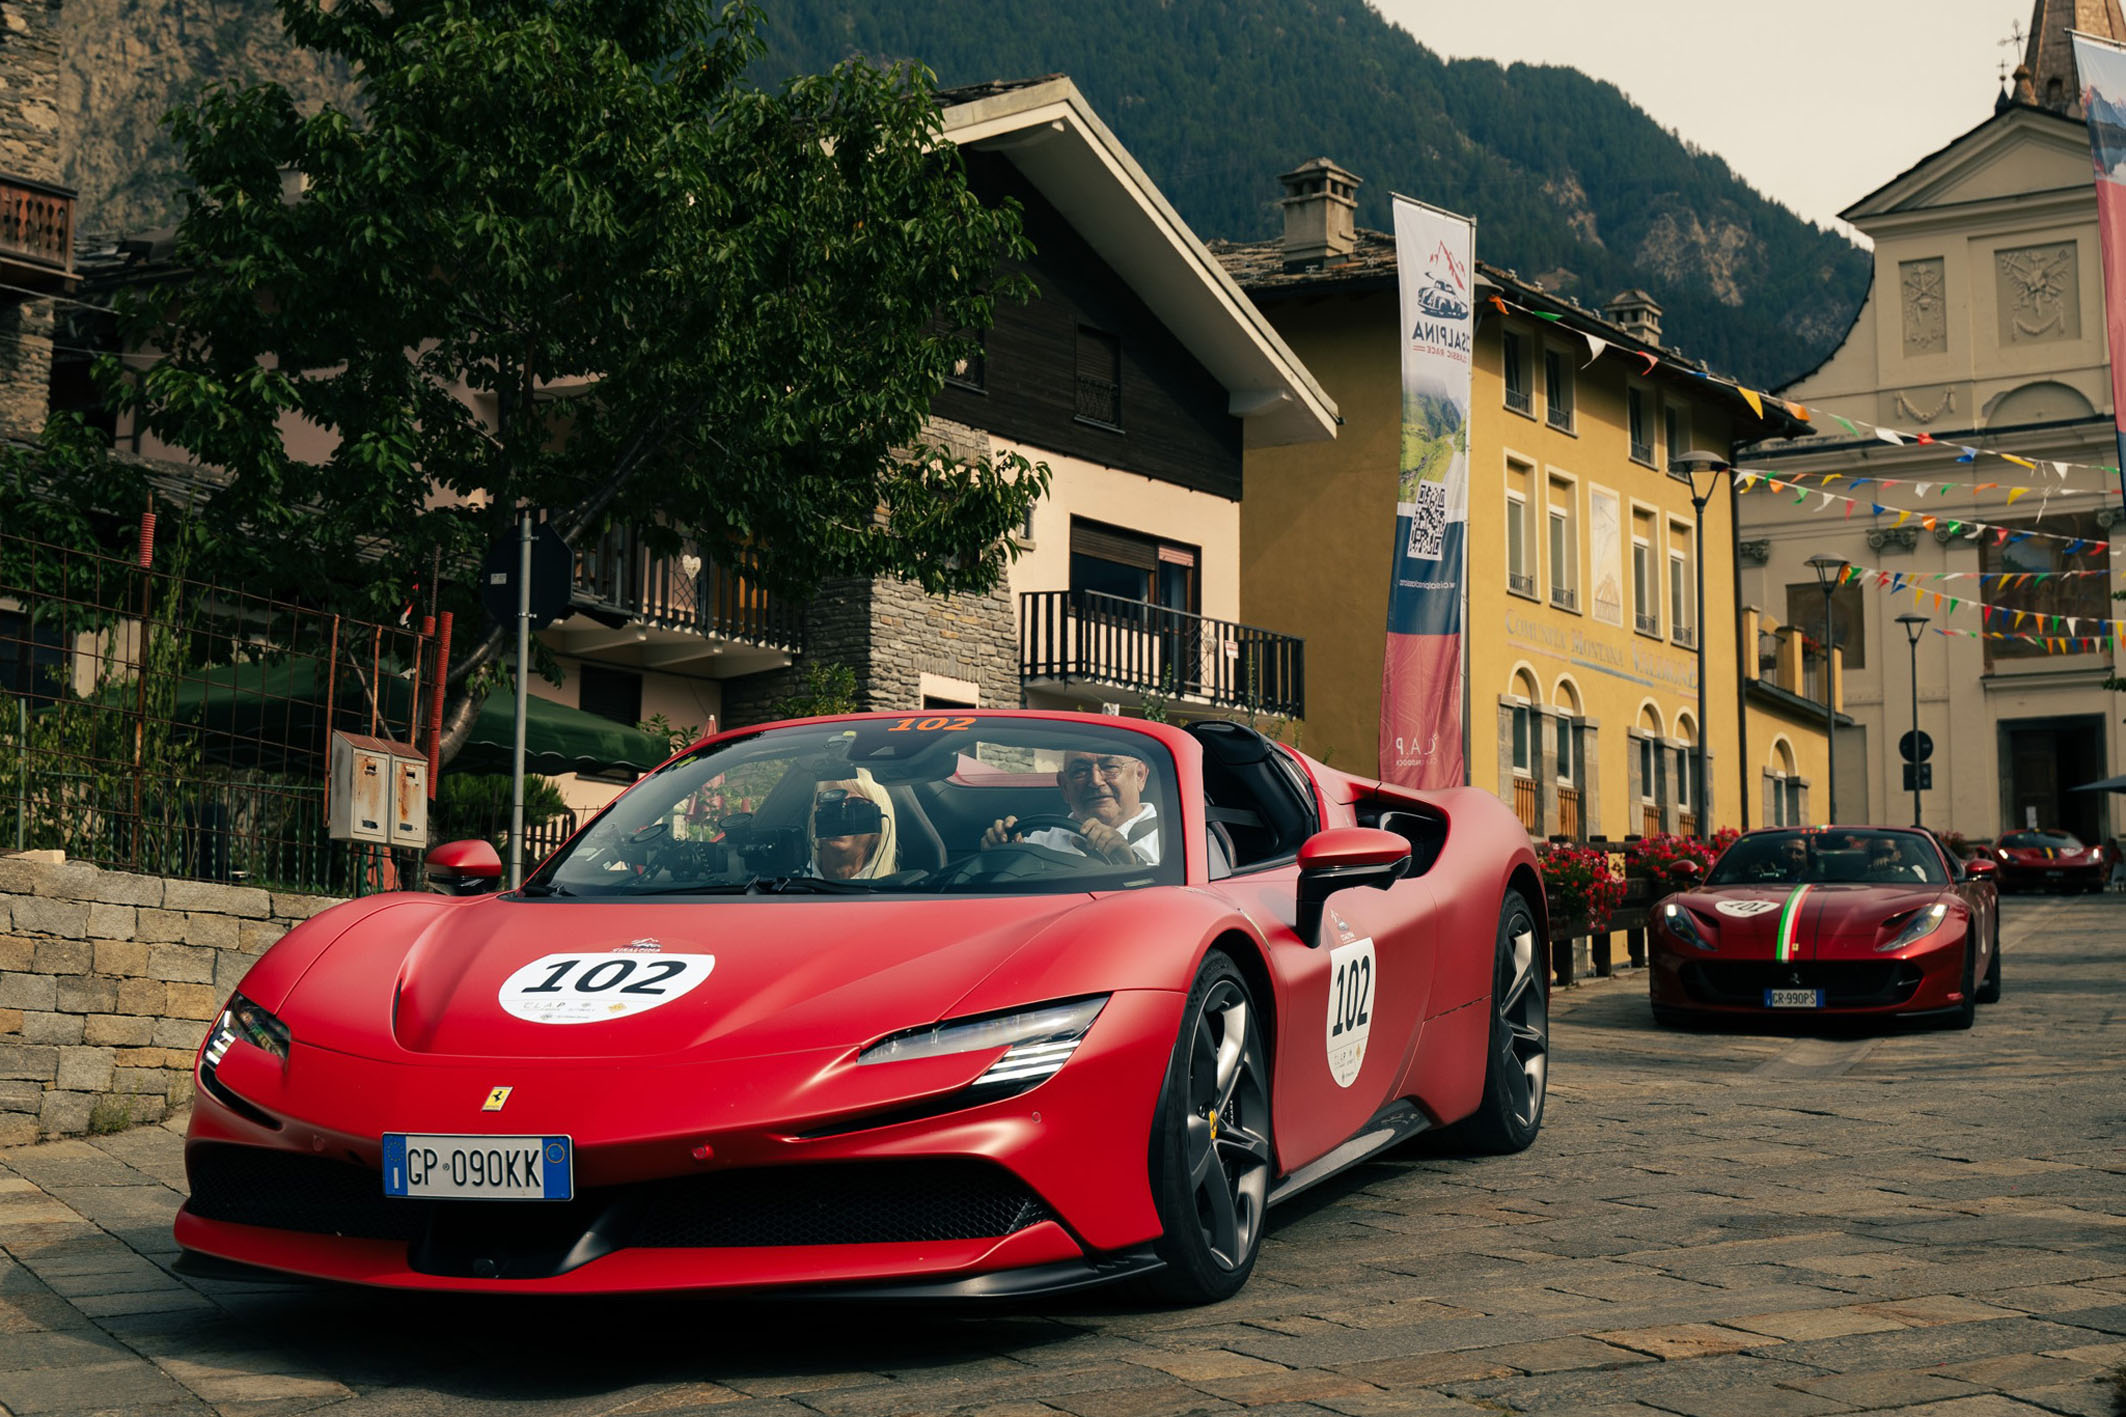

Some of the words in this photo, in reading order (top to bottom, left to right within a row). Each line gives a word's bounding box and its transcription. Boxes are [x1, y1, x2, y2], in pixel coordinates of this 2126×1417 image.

[887, 717, 977, 732] 102
[1723, 902, 1771, 912] 101
[520, 959, 688, 995] 102
[1331, 954, 1371, 1037] 102
